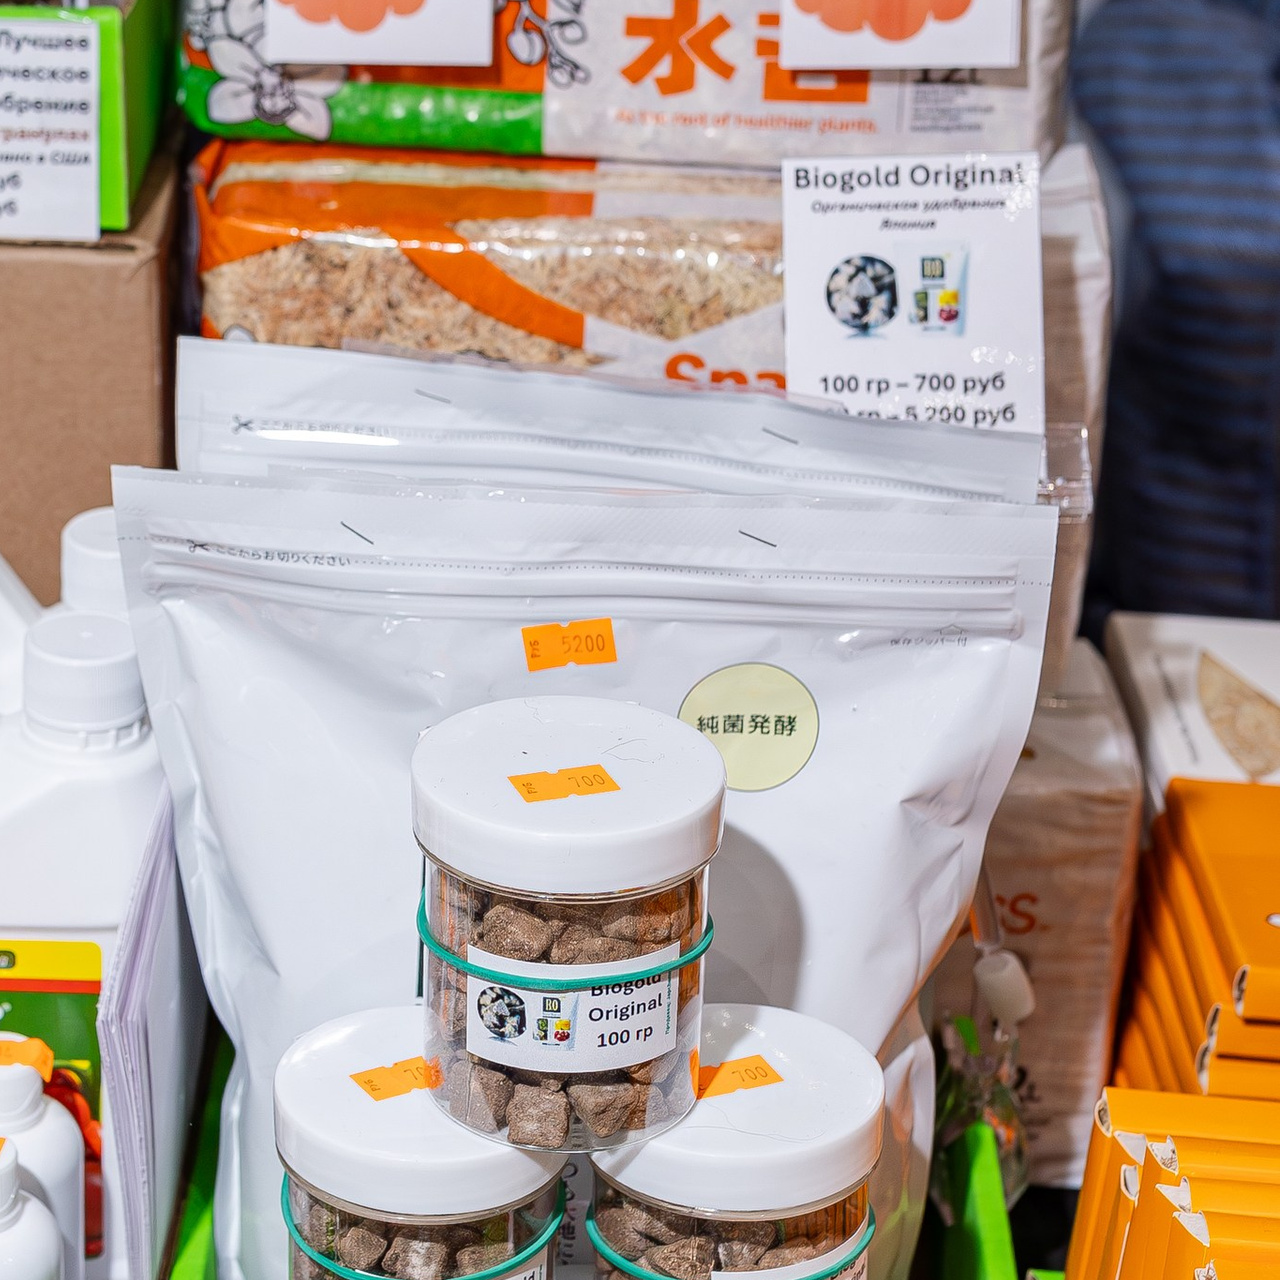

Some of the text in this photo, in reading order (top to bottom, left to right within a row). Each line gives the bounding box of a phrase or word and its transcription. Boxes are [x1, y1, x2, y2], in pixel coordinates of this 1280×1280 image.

[795, 164, 1024, 193] Biogold Original
[821, 372, 1005, 398] 100 гр 700 руб
[974, 403, 1016, 426] руб
[561, 634, 606, 654] 5200
[696, 714, 797, 737] 純菌発酵
[567, 774, 605, 788] 700
[588, 996, 663, 1023] Original
[597, 1025, 653, 1048] 100 гр
[732, 1065, 768, 1083] 700
